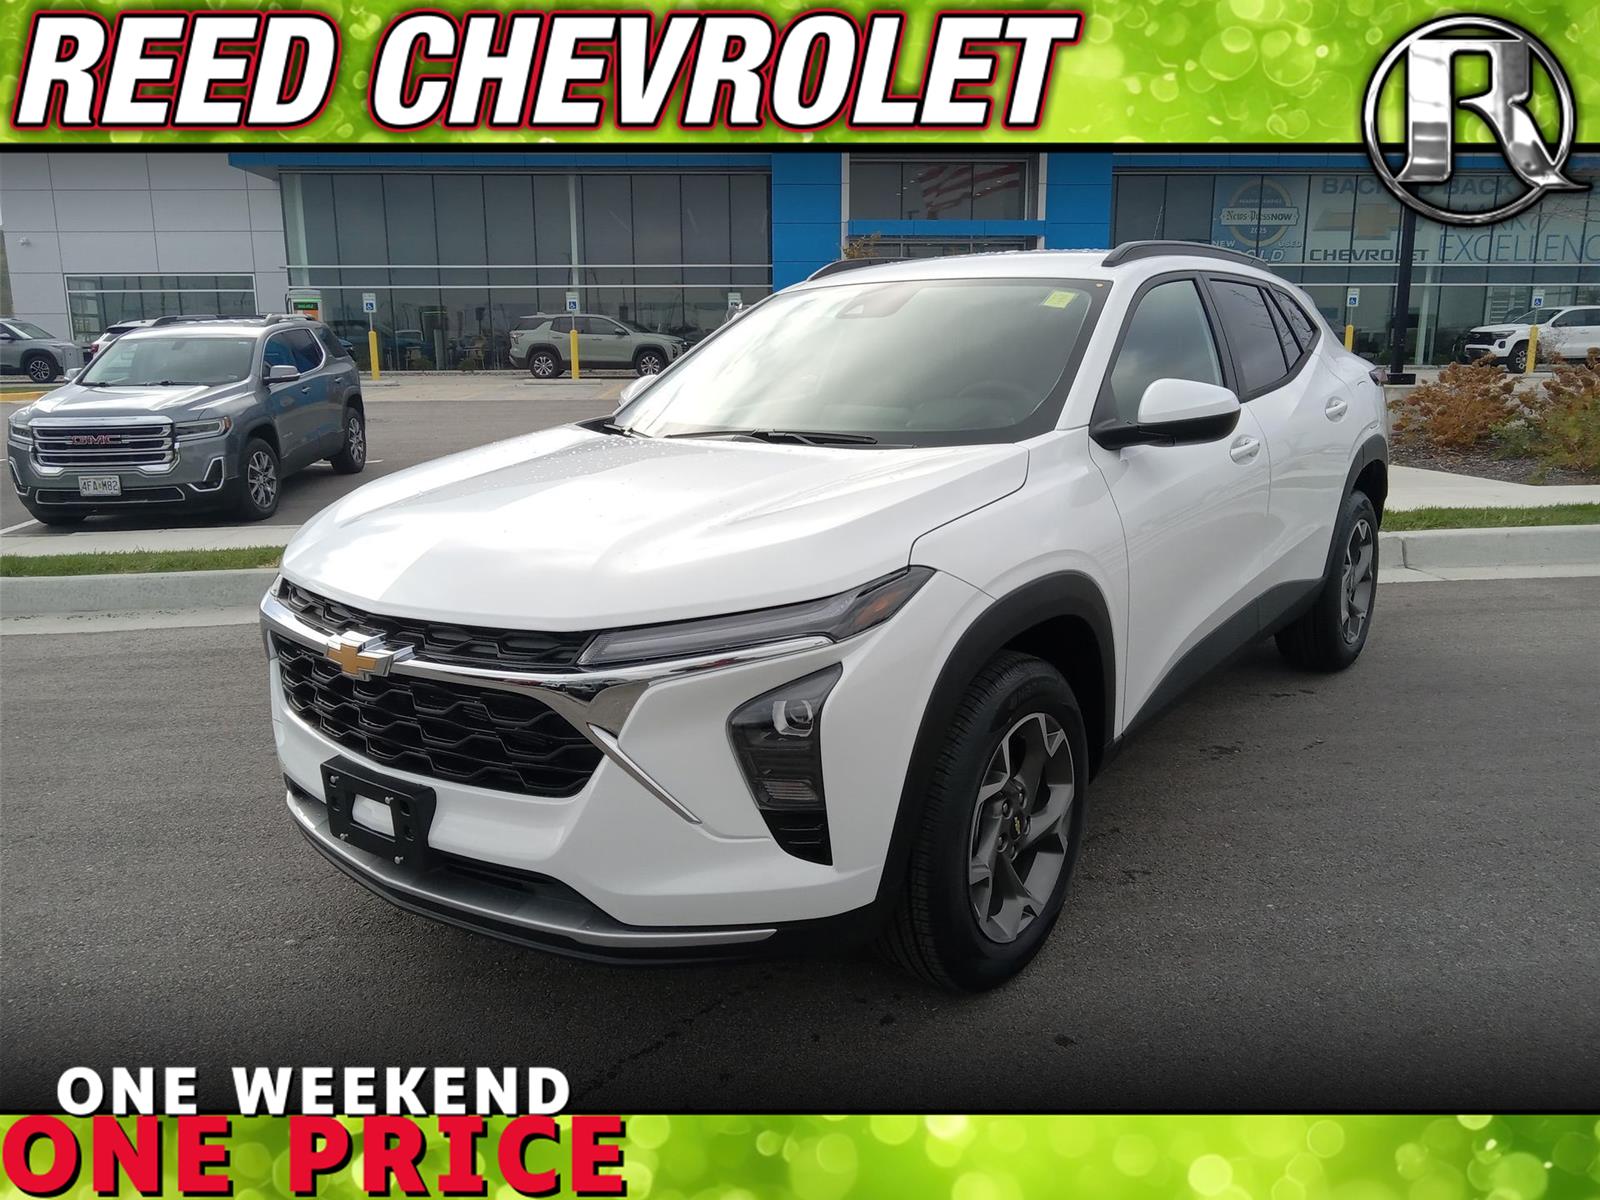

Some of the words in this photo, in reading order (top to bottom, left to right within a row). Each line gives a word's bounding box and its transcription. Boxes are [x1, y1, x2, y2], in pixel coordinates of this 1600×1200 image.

[1322, 178, 1384, 194] BAC
[1309, 249, 1429, 261] CHEVROET
[71, 435, 113, 445] GMC
